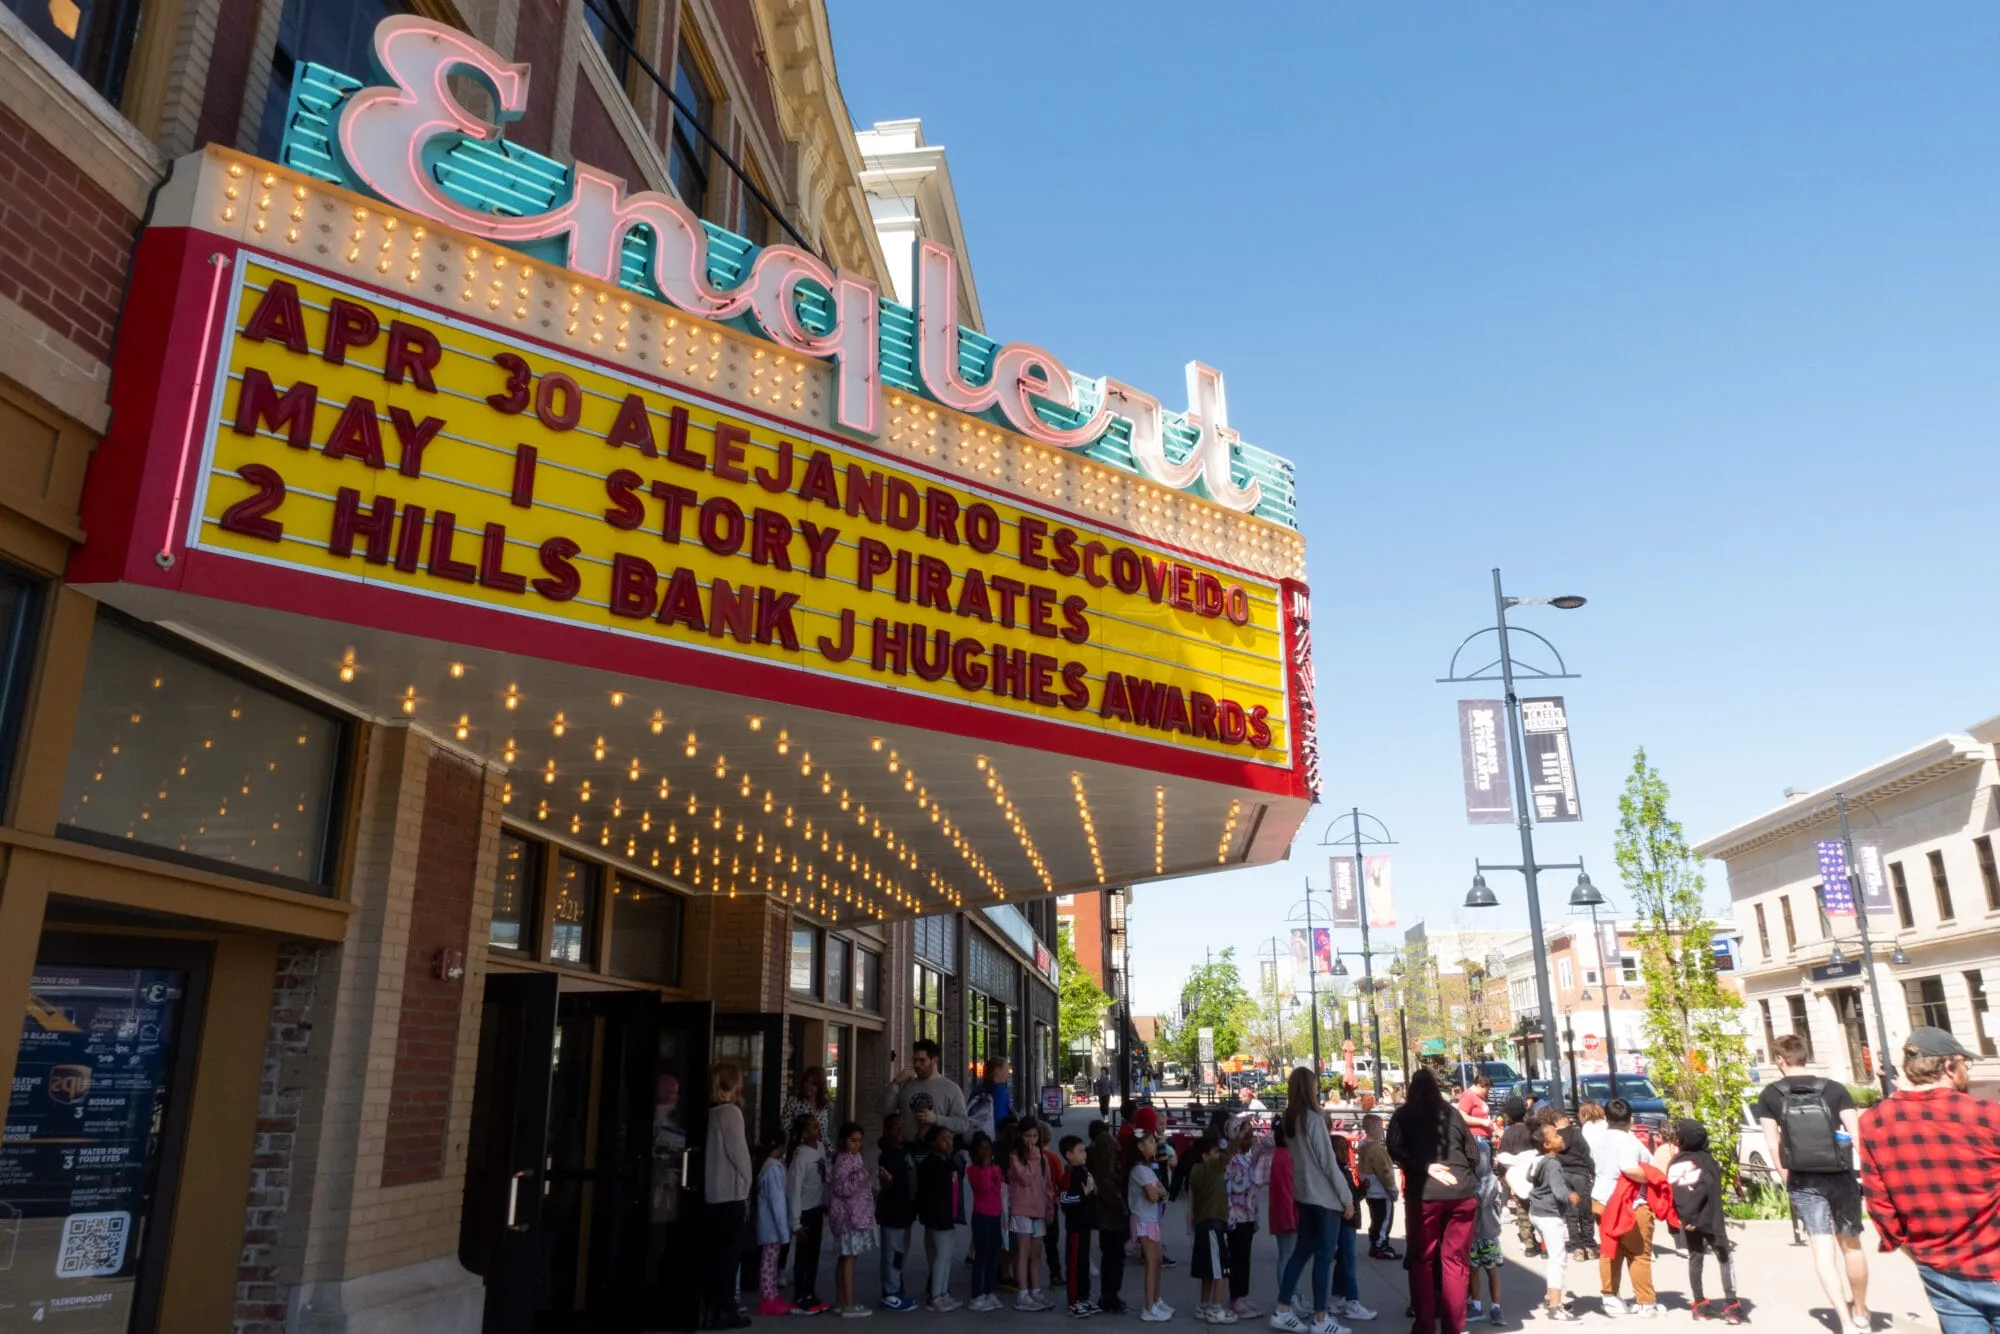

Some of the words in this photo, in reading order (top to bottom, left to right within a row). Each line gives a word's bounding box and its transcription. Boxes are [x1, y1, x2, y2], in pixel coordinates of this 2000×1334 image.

[338, 14, 1264, 513] Englert
[242, 278, 442, 393] APR
[486, 352, 582, 432] 30
[606, 394, 1000, 554] ALEJANDRO
[1019, 516, 1249, 626] ESCOVEDO
[234, 367, 446, 479] MAY
[604, 469, 840, 579] STORY
[858, 537, 1089, 644] PIRATES
[220, 463, 286, 542] 2
[329, 486, 582, 601] HILLS
[610, 552, 801, 652] BANK
[818, 608, 855, 662] J
[872, 617, 1089, 711] HUGHES
[1100, 671, 1272, 749] AWARDS
[1530, 710, 1560, 719] CREEK
[1527, 719, 1566, 728] FESTIVAL
[559, 898, 578, 922] 221
[30, 1032, 59, 1040] BLACK
[1582, 1037, 1600, 1046] STOP
[12, 1076, 43, 1086] ELEINE
[12, 1084, 33, 1093] OUX
[73, 1106, 84, 1119] 3
[107, 1147, 130, 1155] FROM
[62, 1155, 75, 1170] 3
[78, 1155, 101, 1163] YOUR
